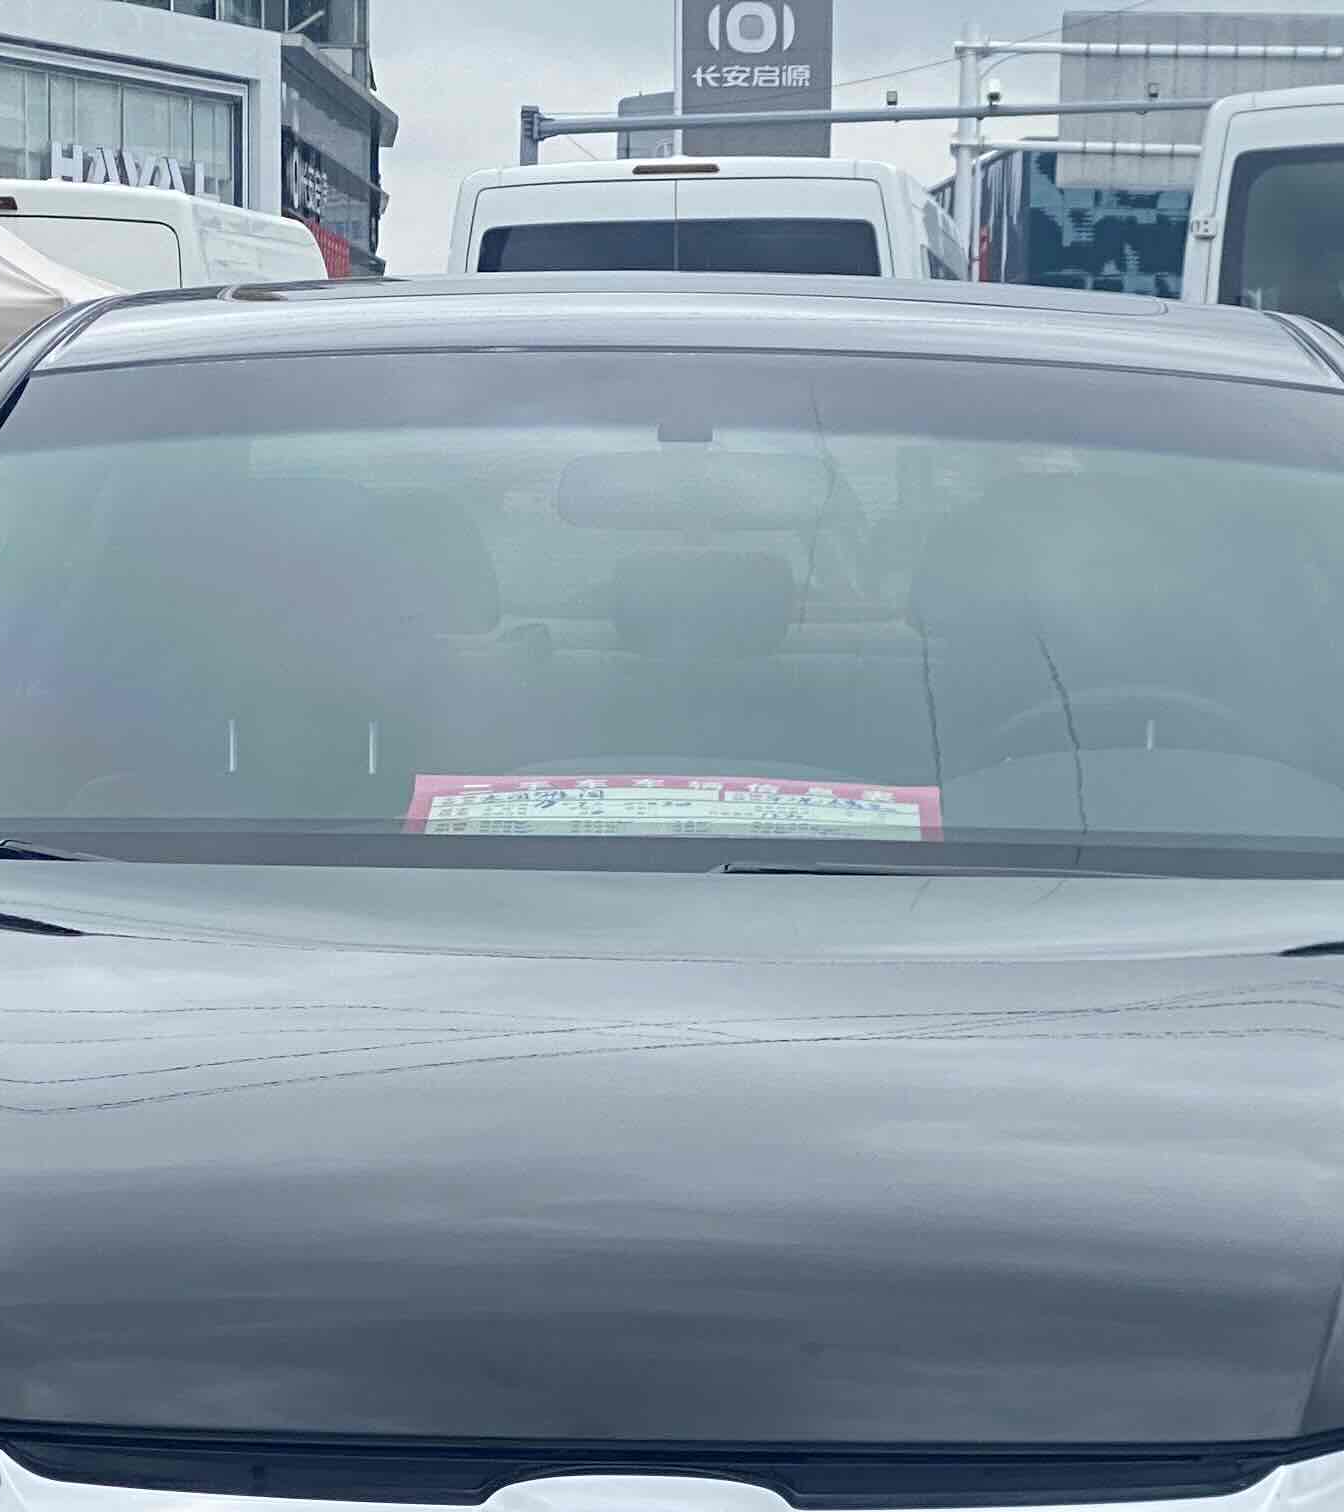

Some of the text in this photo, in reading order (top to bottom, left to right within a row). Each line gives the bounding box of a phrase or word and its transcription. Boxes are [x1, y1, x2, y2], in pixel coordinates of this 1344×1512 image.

[691, 64, 811, 88] 长安启源
[51, 143, 221, 203] HAVAL
